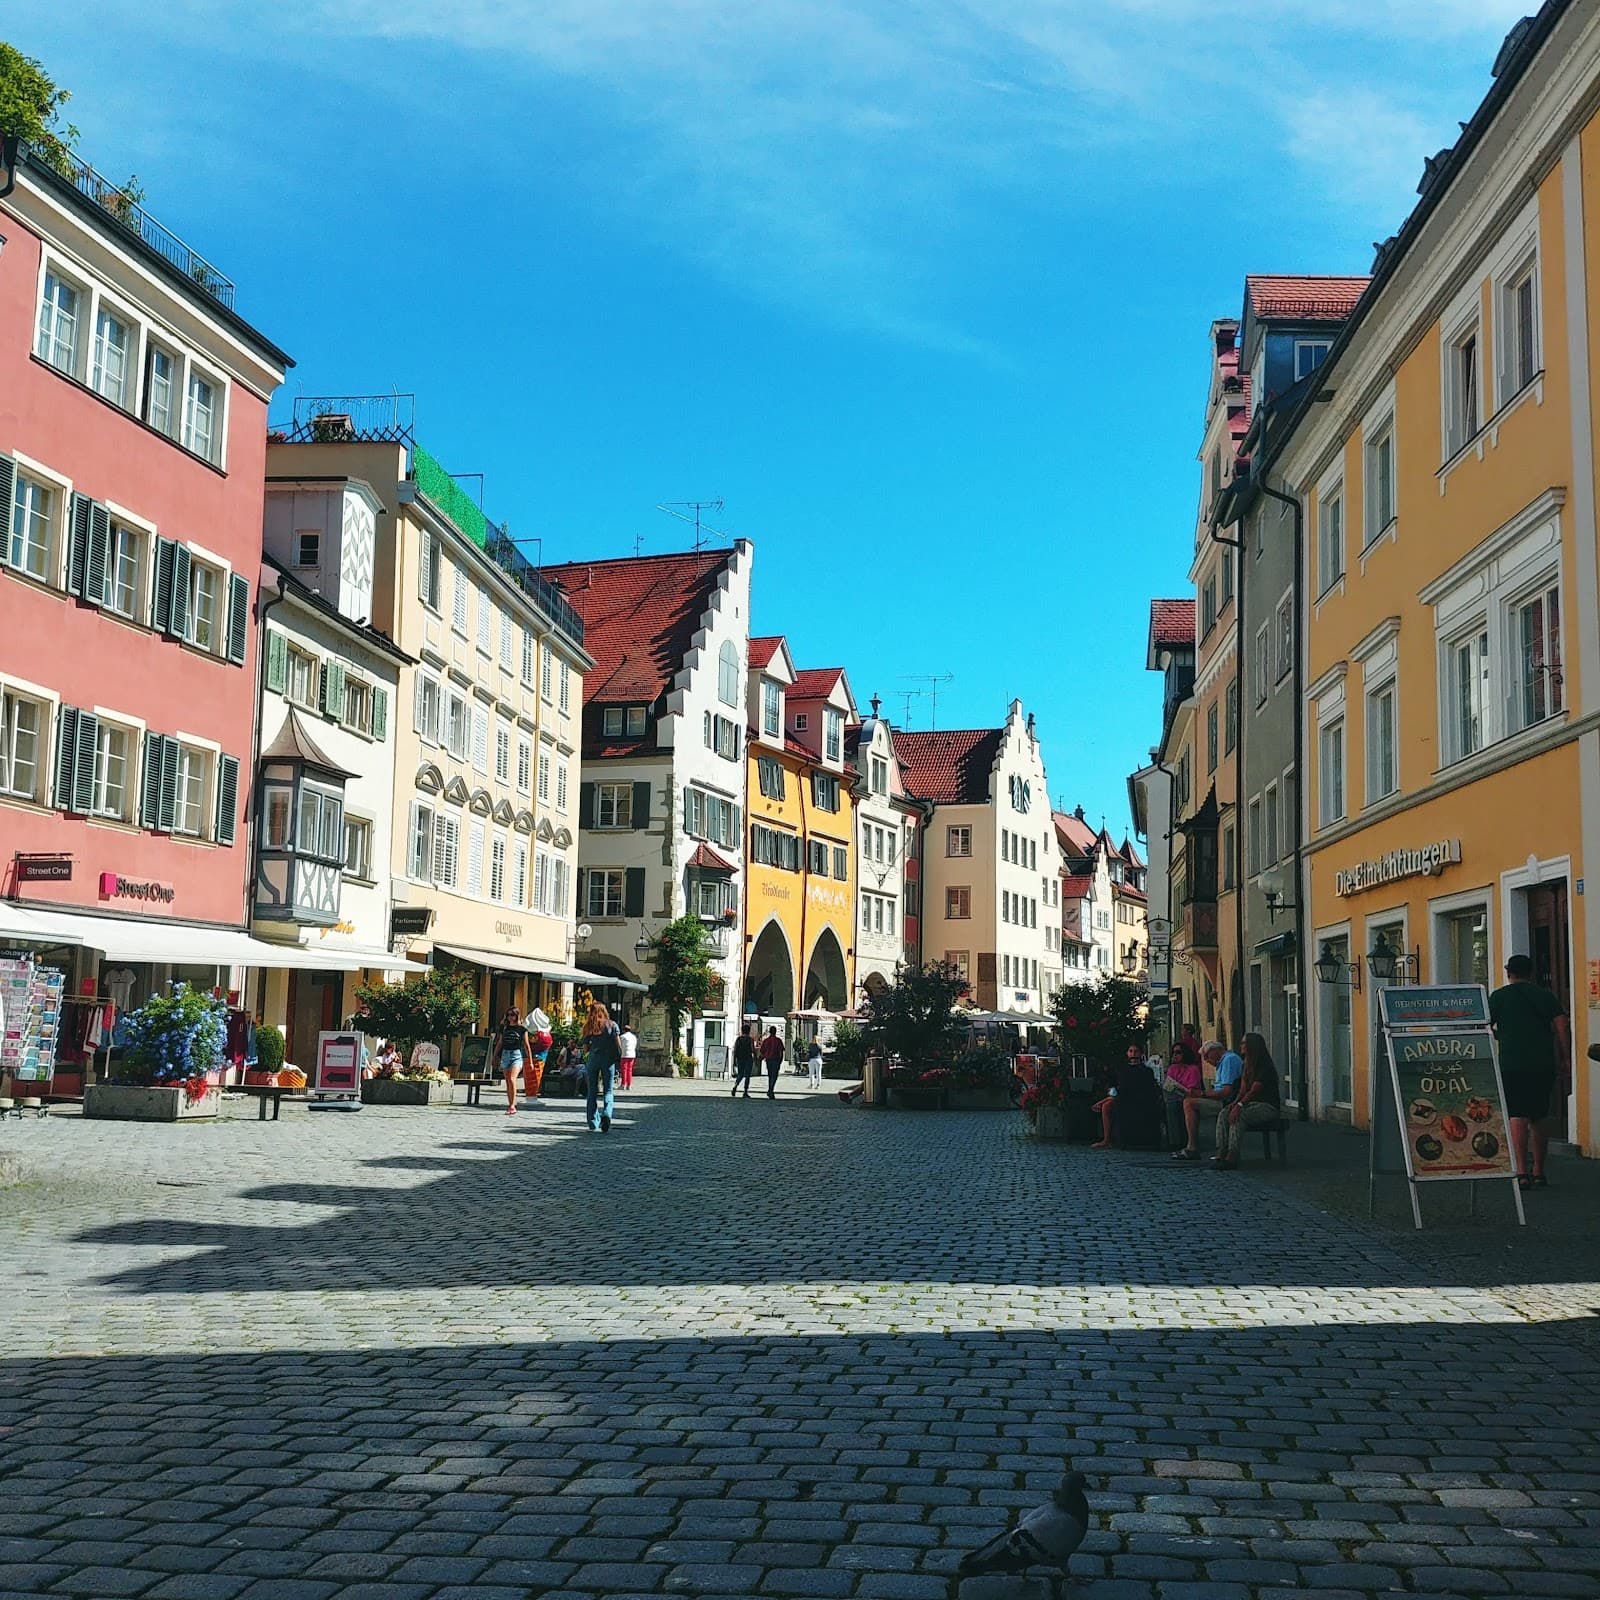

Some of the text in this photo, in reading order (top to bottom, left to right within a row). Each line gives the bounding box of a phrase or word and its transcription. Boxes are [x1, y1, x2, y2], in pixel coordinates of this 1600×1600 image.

[27, 866, 69, 875] Street One
[1335, 839, 1450, 897] Die Einrichtungen
[116, 877, 174, 903] Street One
[1395, 999, 1440, 1008] BERNSTEIN
[1452, 998, 1473, 1007] MEER
[1403, 1039, 1477, 1063] AMBRA
[1420, 1077, 1473, 1094] OPAL
